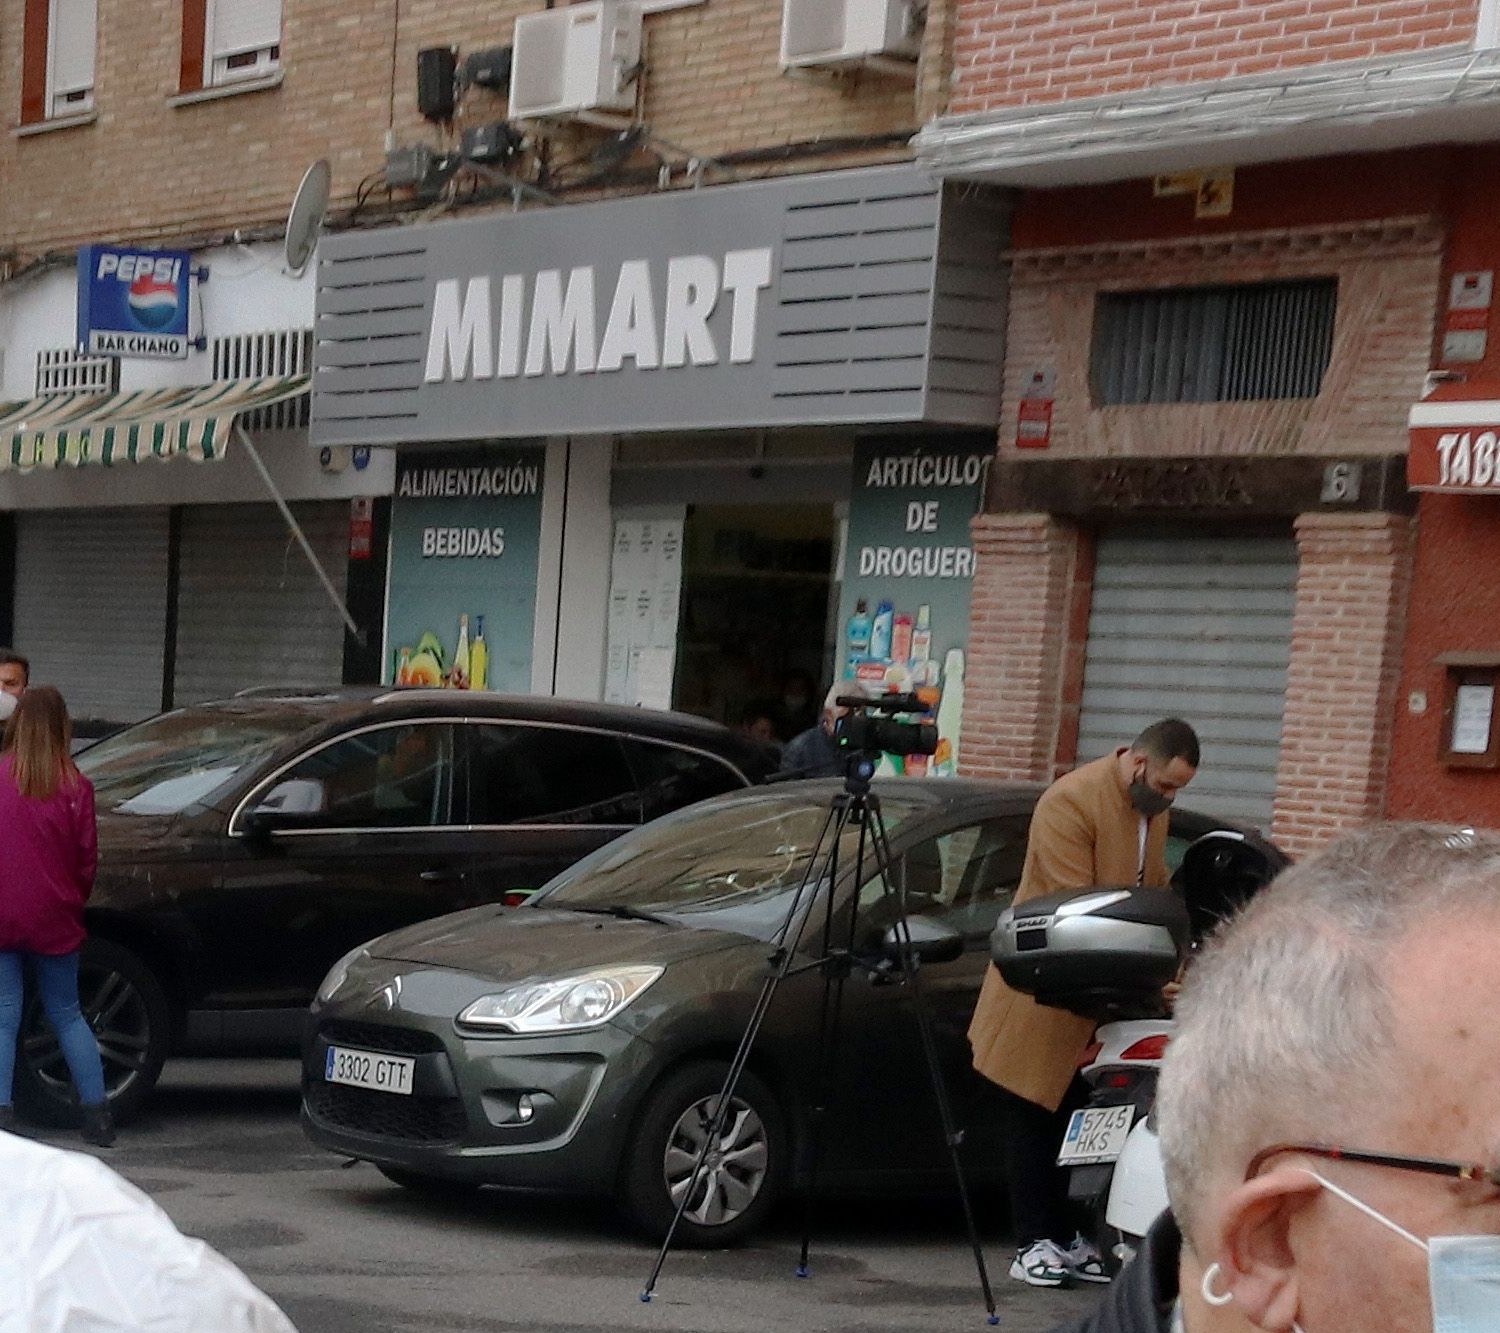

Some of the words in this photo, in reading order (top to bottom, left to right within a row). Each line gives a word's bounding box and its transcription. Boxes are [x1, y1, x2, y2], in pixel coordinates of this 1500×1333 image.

[97, 253, 182, 282] PEPSI
[424, 248, 772, 383] MIMART
[98, 335, 124, 351] BAR
[129, 336, 179, 354] CHANO
[400, 461, 538, 496] ALIMENTACIÓN
[1333, 461, 1349, 498] 6
[906, 501, 940, 532] DE
[422, 527, 505, 558] BEBIDAS
[338, 1053, 370, 1083] 3302
[376, 1060, 406, 1089] GTT
[1082, 1106, 1128, 1132] 5745
[1076, 1131, 1110, 1153] HKS
